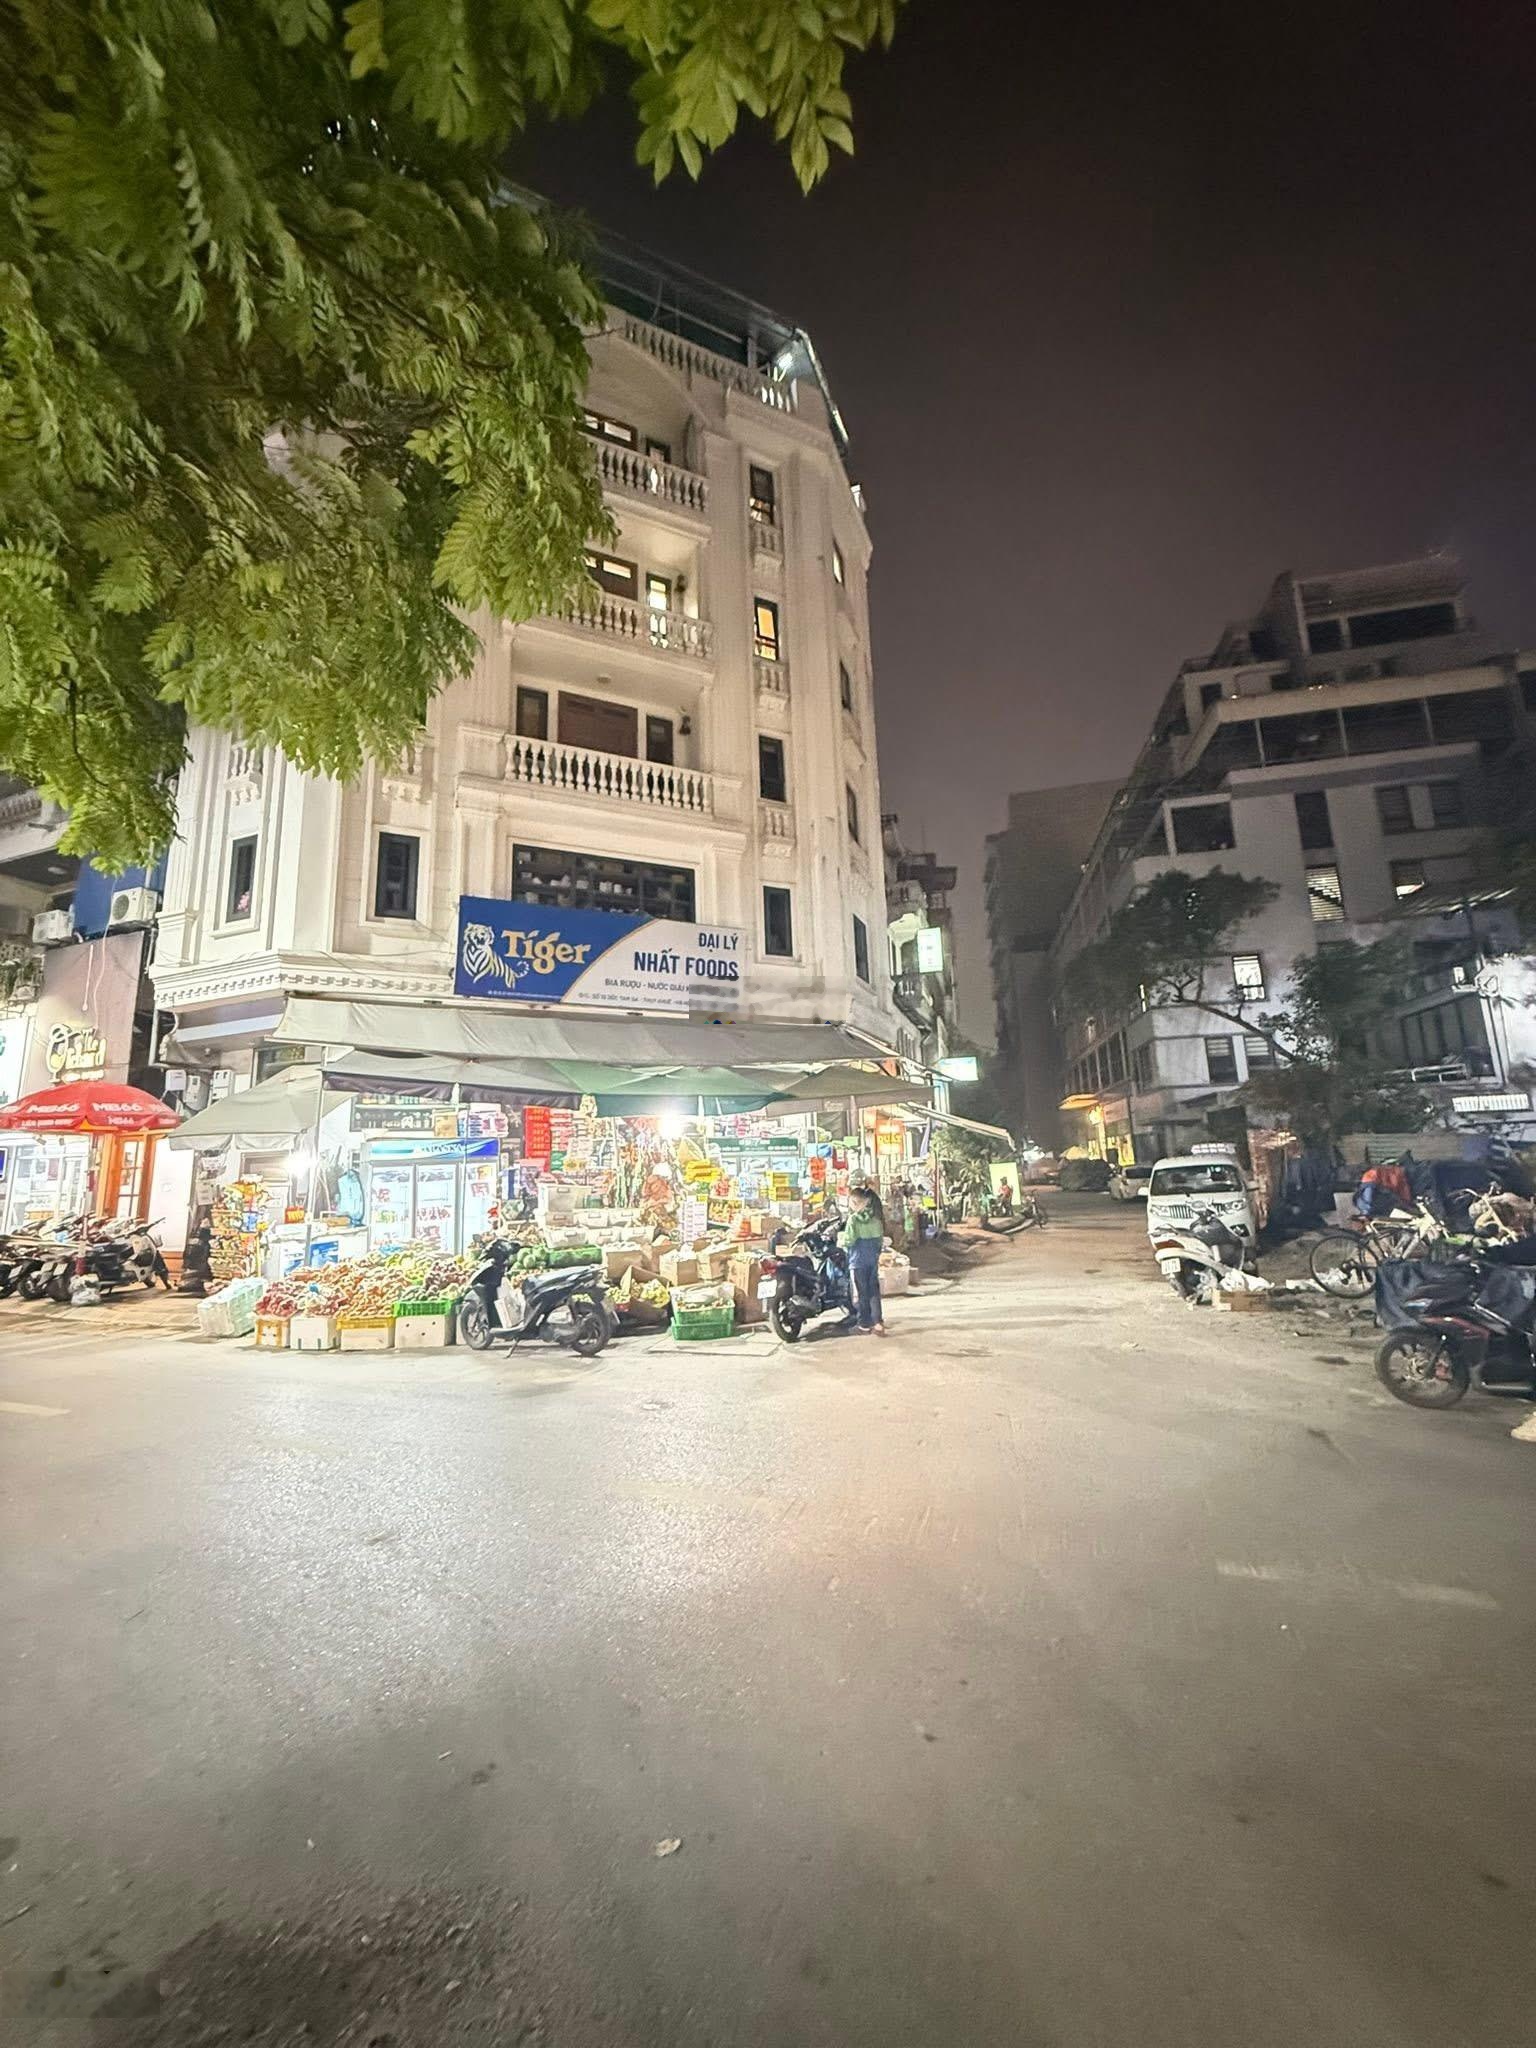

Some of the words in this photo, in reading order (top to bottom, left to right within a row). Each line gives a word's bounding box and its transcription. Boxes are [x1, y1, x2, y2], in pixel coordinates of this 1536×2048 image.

[698, 932, 720, 952] ĐẠI
[723, 932, 739, 950] LÝ
[634, 948, 681, 974] NHẤT
[685, 957, 739, 980] FOODS
[91, 1103, 144, 1112] MB66
